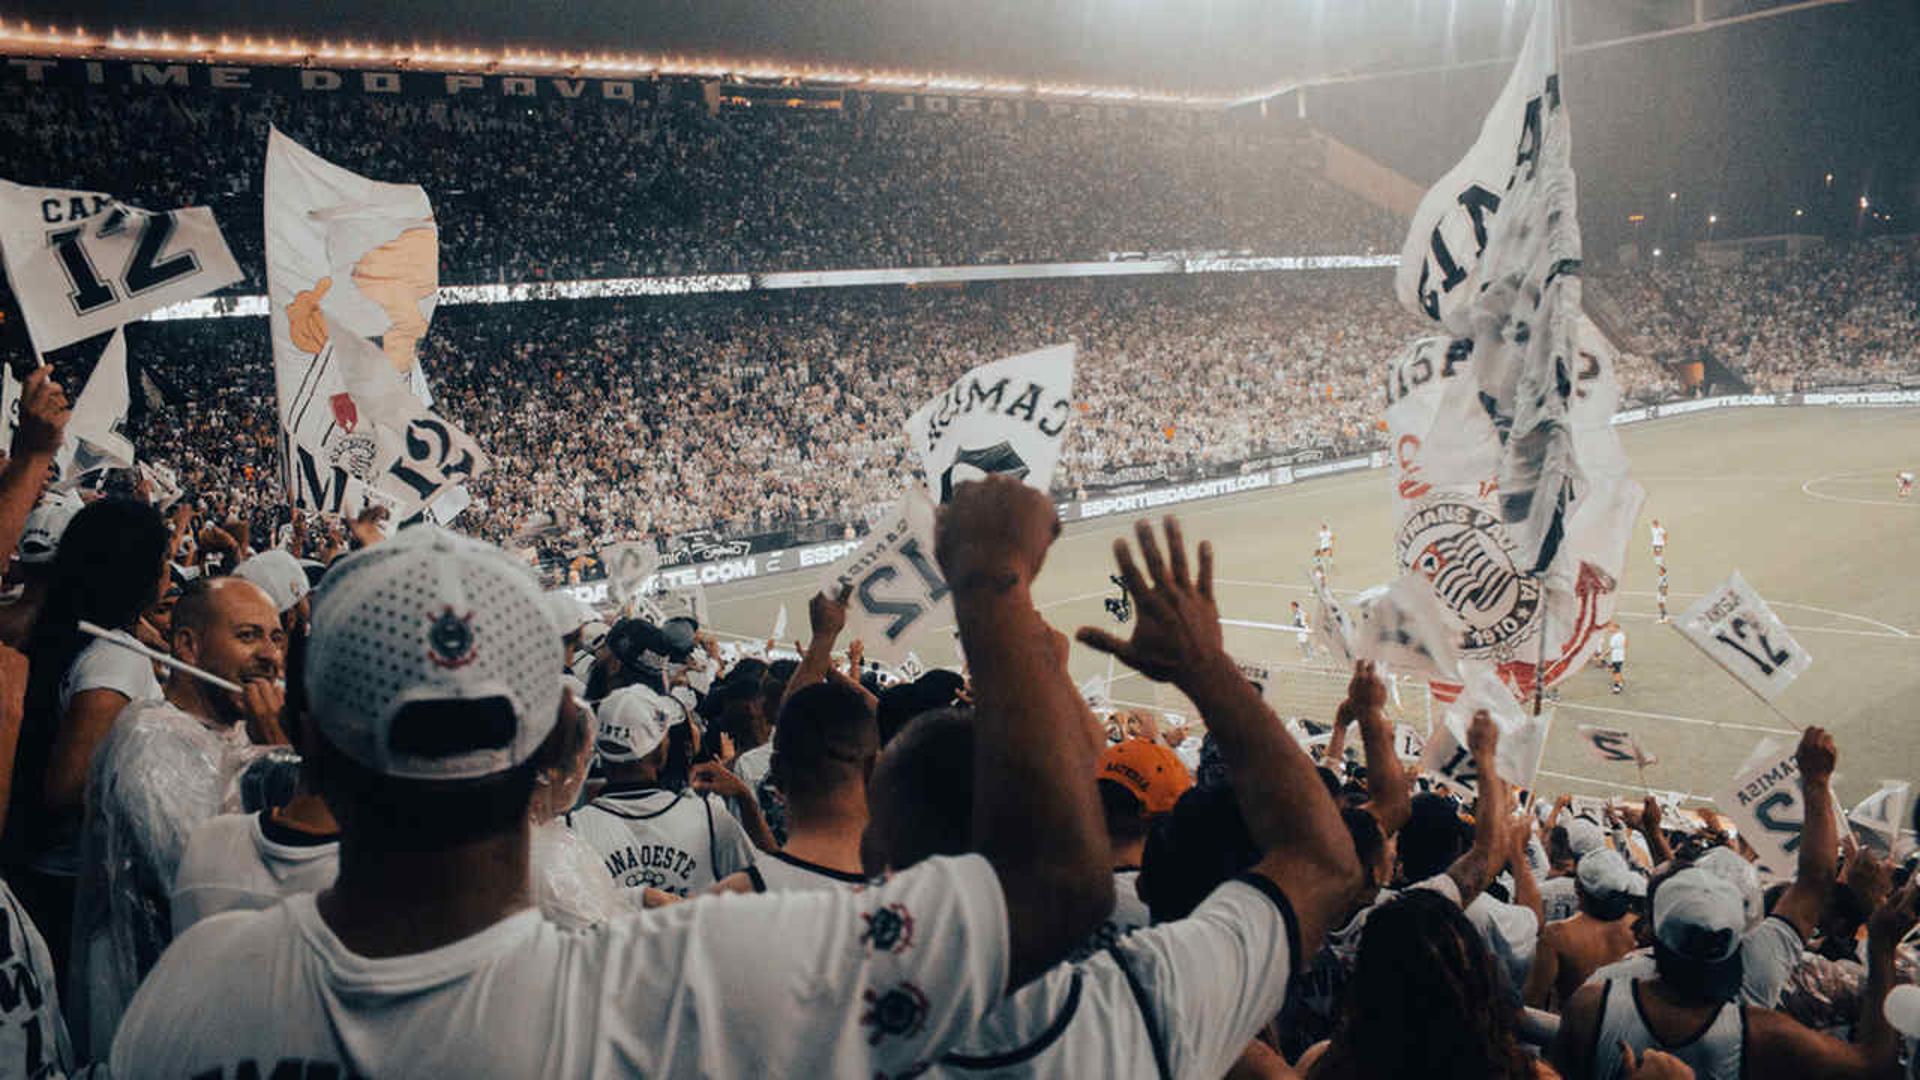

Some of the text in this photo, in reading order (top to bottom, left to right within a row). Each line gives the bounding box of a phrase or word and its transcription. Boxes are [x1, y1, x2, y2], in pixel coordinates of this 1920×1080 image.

[8, 58, 635, 101] TIME DO POVO
[46, 208, 203, 317] 12
[388, 419, 475, 501] 12
[1716, 617, 1790, 677] 12
